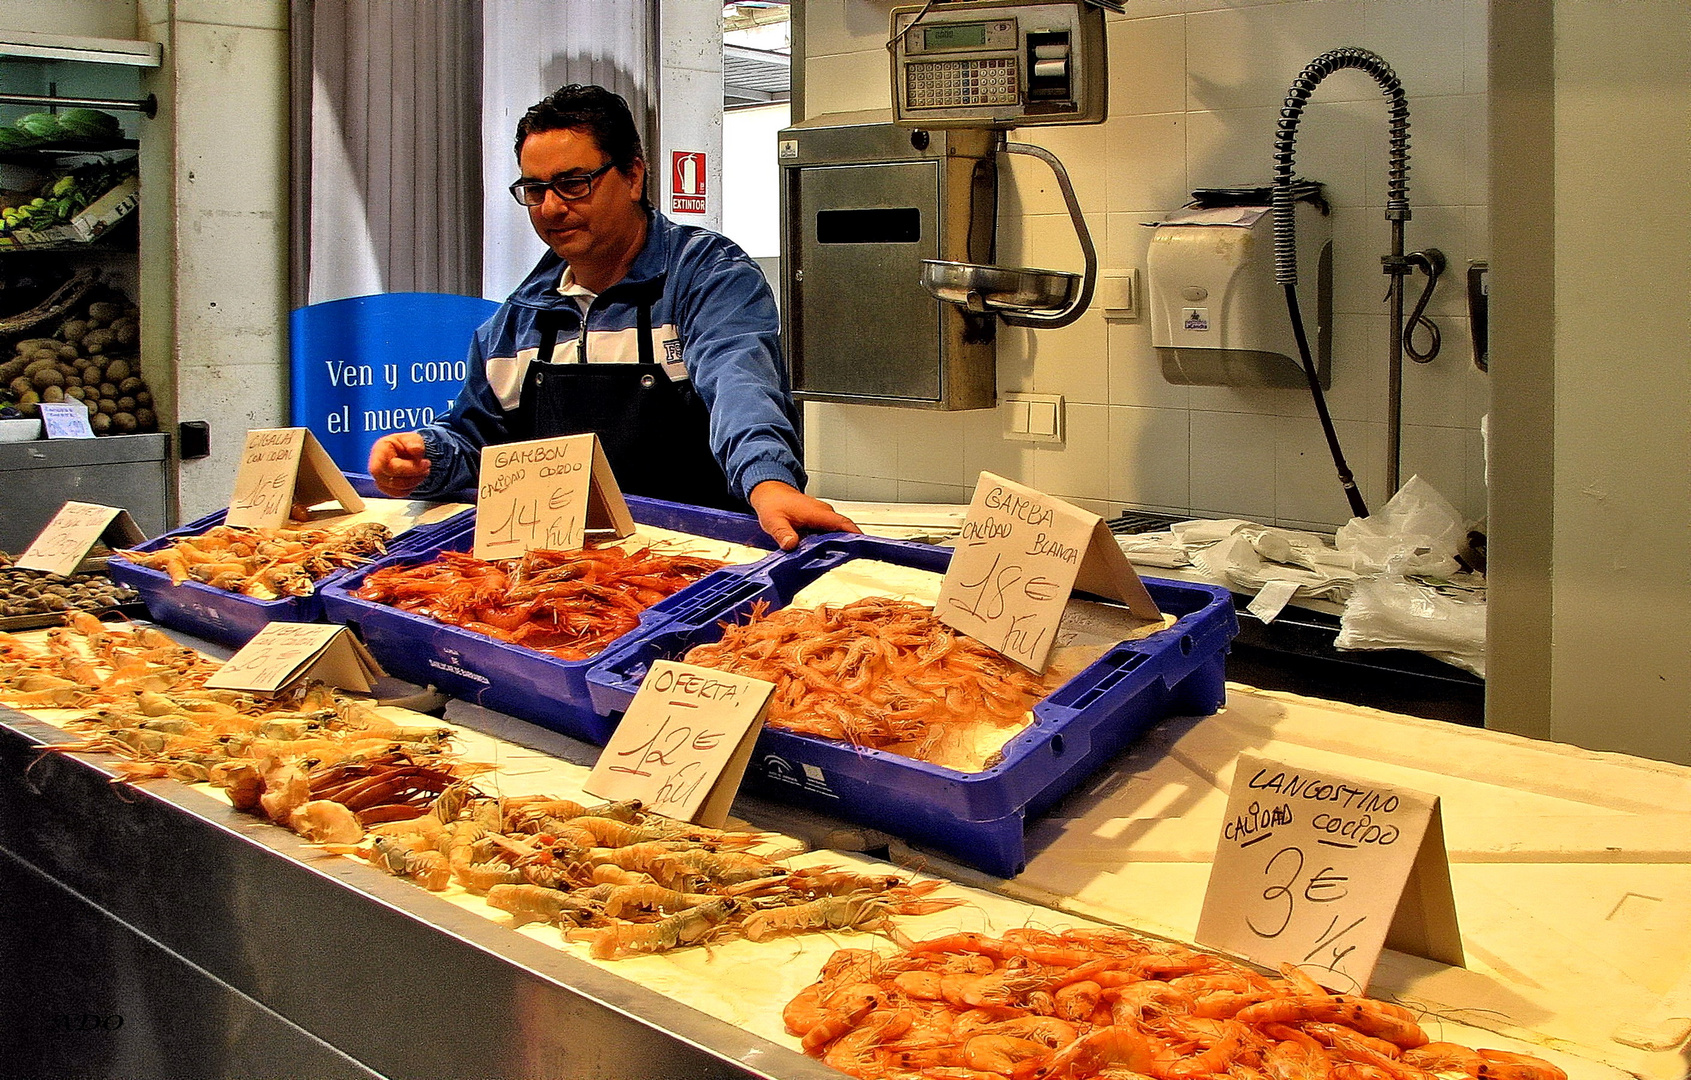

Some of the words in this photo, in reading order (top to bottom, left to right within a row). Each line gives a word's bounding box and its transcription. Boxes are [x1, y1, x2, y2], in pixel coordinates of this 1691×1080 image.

[673, 198, 705, 211] EXTINTOR
[325, 360, 373, 387] Ven
[384, 363, 398, 391] y
[411, 360, 467, 383] cono
[327, 405, 350, 434] el
[364, 406, 434, 432] nuevo
[494, 443, 569, 469] GAMBON
[480, 468, 526, 500] CALIDAD
[985, 487, 1054, 528] GAMBA
[963, 516, 1012, 540] CALIDAD
[1248, 769, 1399, 812] LANGOSTINO
[1225, 801, 1293, 841] CALIDAD
[1312, 814, 1400, 846] COCIDO
